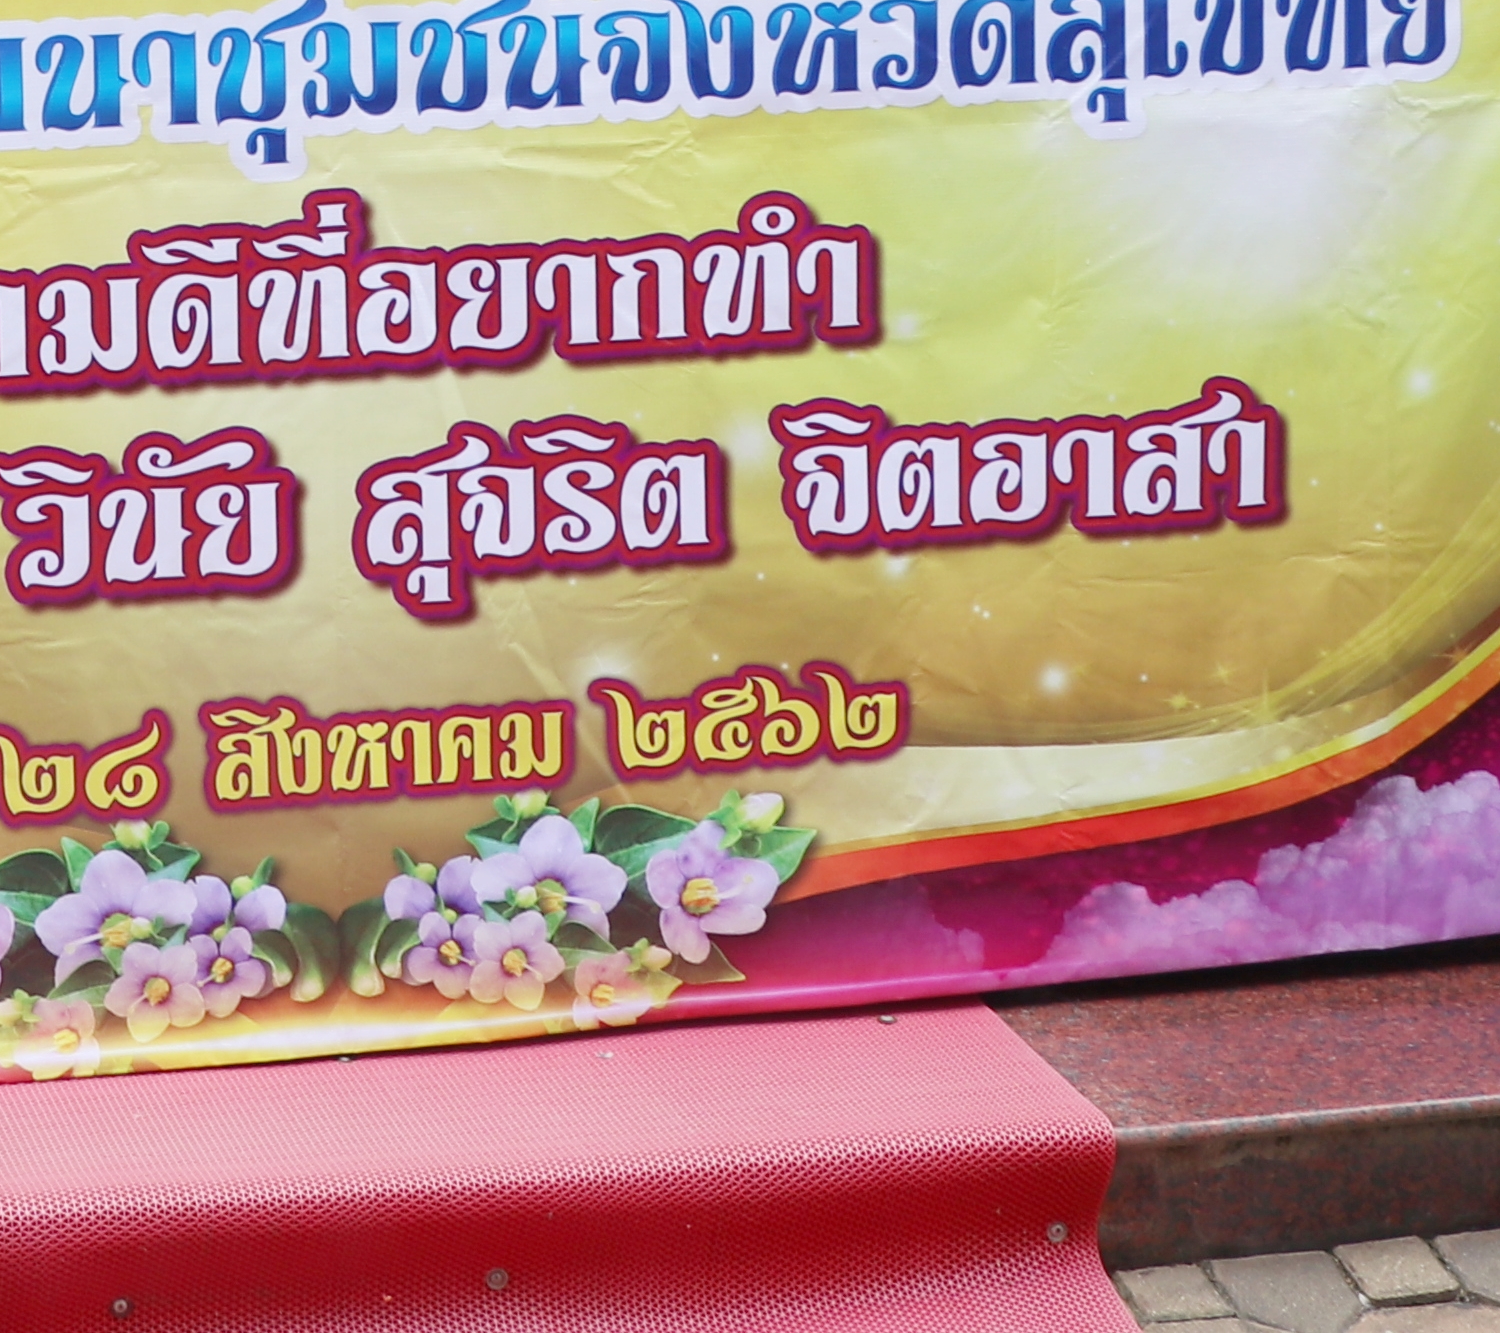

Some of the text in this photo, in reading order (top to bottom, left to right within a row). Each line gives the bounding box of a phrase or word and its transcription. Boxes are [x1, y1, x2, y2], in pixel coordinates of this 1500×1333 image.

[365, 425, 711, 605] สุจริต
[780, 388, 1268, 538] จิตอาสา
[208, 704, 565, 803] สิงหาคม
[600, 670, 901, 769] ๒๕๖๒
